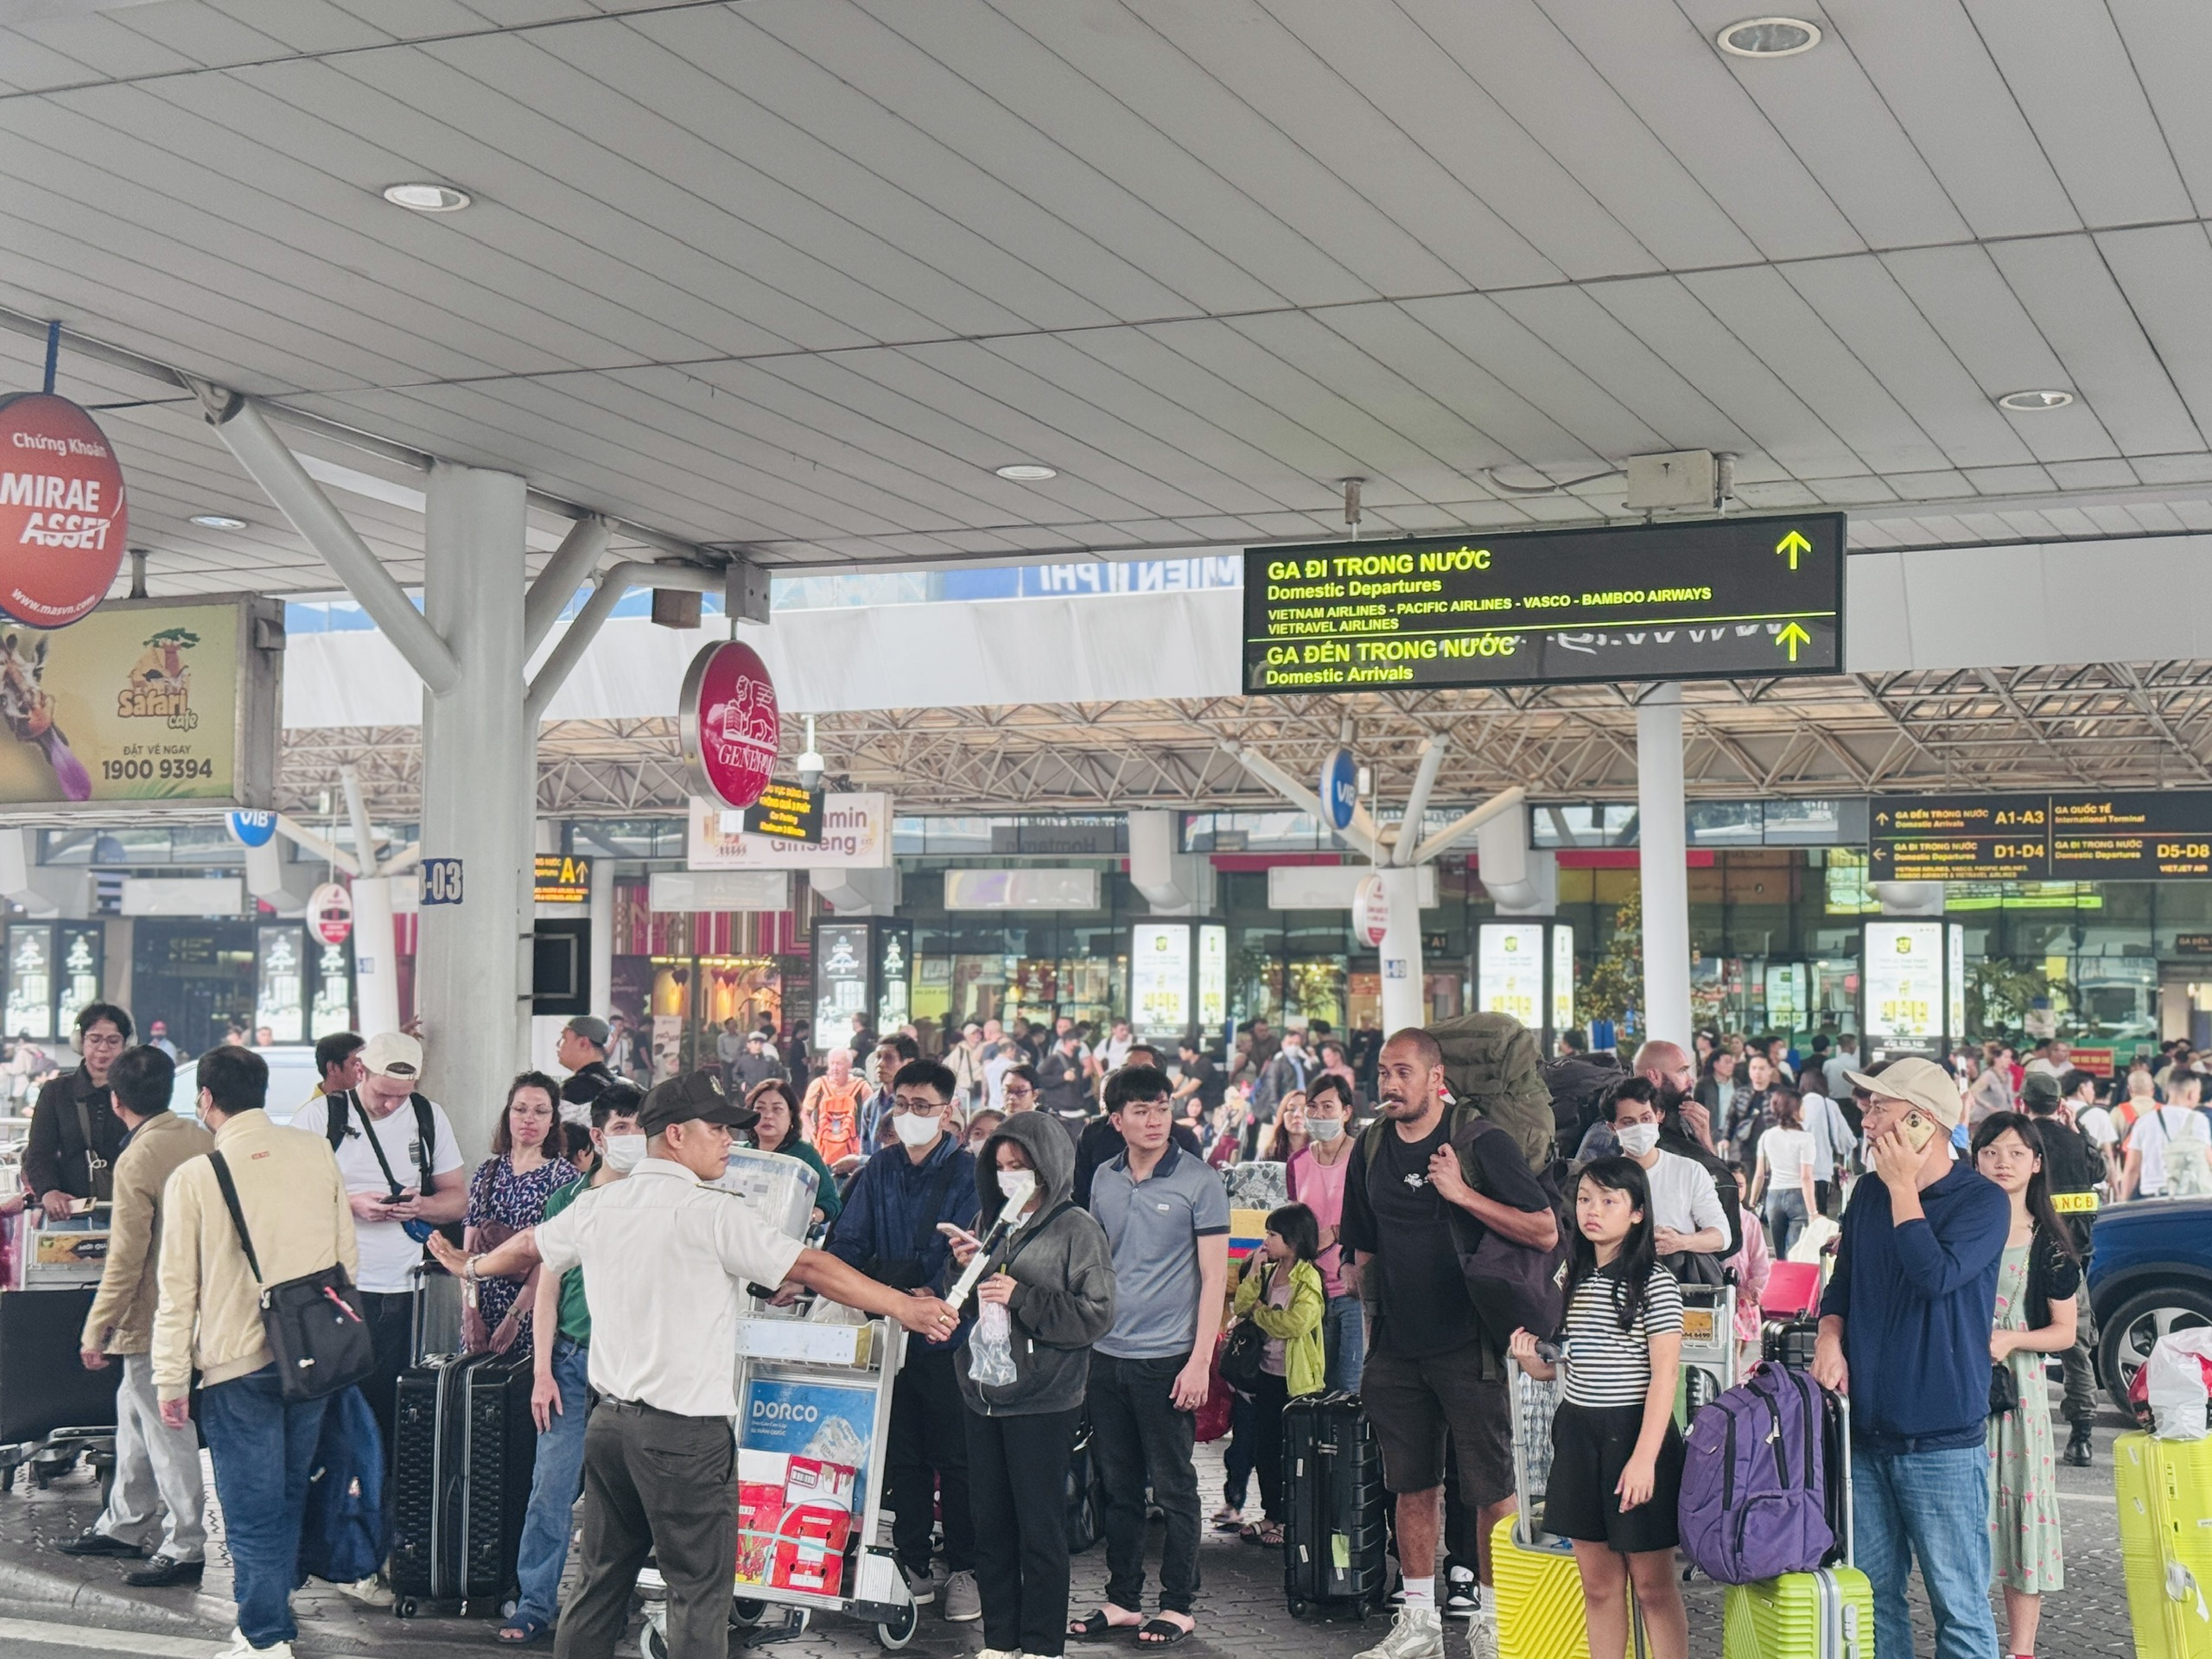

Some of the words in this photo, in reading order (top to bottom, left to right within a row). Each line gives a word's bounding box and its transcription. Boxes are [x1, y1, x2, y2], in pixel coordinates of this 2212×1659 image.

[13, 432, 67, 456] Chứng
[67, 437, 107, 458] Khoán
[0, 473, 101, 512] MIRAE
[20, 512, 111, 550] ASSET
[1268, 561, 1301, 581] GA
[1305, 560, 1328, 578] ĐI
[1333, 554, 1414, 577] TRONG
[1420, 546, 1491, 573] NƯỚC
[1268, 582, 1344, 601] Domestic
[1349, 579, 1442, 599] Departures
[11, 588, 96, 616] www.masvn.com
[1268, 607, 1325, 620] VIETNAM
[1326, 604, 1386, 619] AIRLINES
[1396, 601, 1448, 615] PACIFIC
[1450, 597, 1512, 613] AIRLINES
[1523, 594, 1571, 609] VASCO
[1582, 590, 1645, 606] BAMBOO
[1647, 587, 1713, 603] AIRWAYS
[1268, 621, 1338, 635] VIETRAVEL
[1339, 618, 1399, 632] AIRLINES
[1267, 645, 1300, 665] GA
[1304, 640, 1351, 664] ĐẾN
[1357, 640, 1438, 662] TRONG
[1443, 632, 1515, 658] NƯỚC
[1266, 668, 1344, 685] Domestic
[1347, 665, 1414, 683] Arrivals
[118, 688, 188, 718] Safari
[168, 708, 198, 732] cafe
[163, 745, 191, 754] NGAY
[102, 760, 153, 779] 1900
[160, 758, 213, 779] 9394
[1337, 780, 1356, 806] VIB
[240, 810, 269, 828] VIB
[1994, 810, 2044, 824] A1-A3
[1932, 853, 1976, 861] Departures
[1994, 844, 2044, 858] D1-D4
[2095, 851, 2141, 860] Departures
[2157, 843, 2209, 858] D5-D8
[559, 857, 575, 883] A
[2159, 864, 2192, 873] VIETJET
[753, 1400, 818, 1422] DORCO
